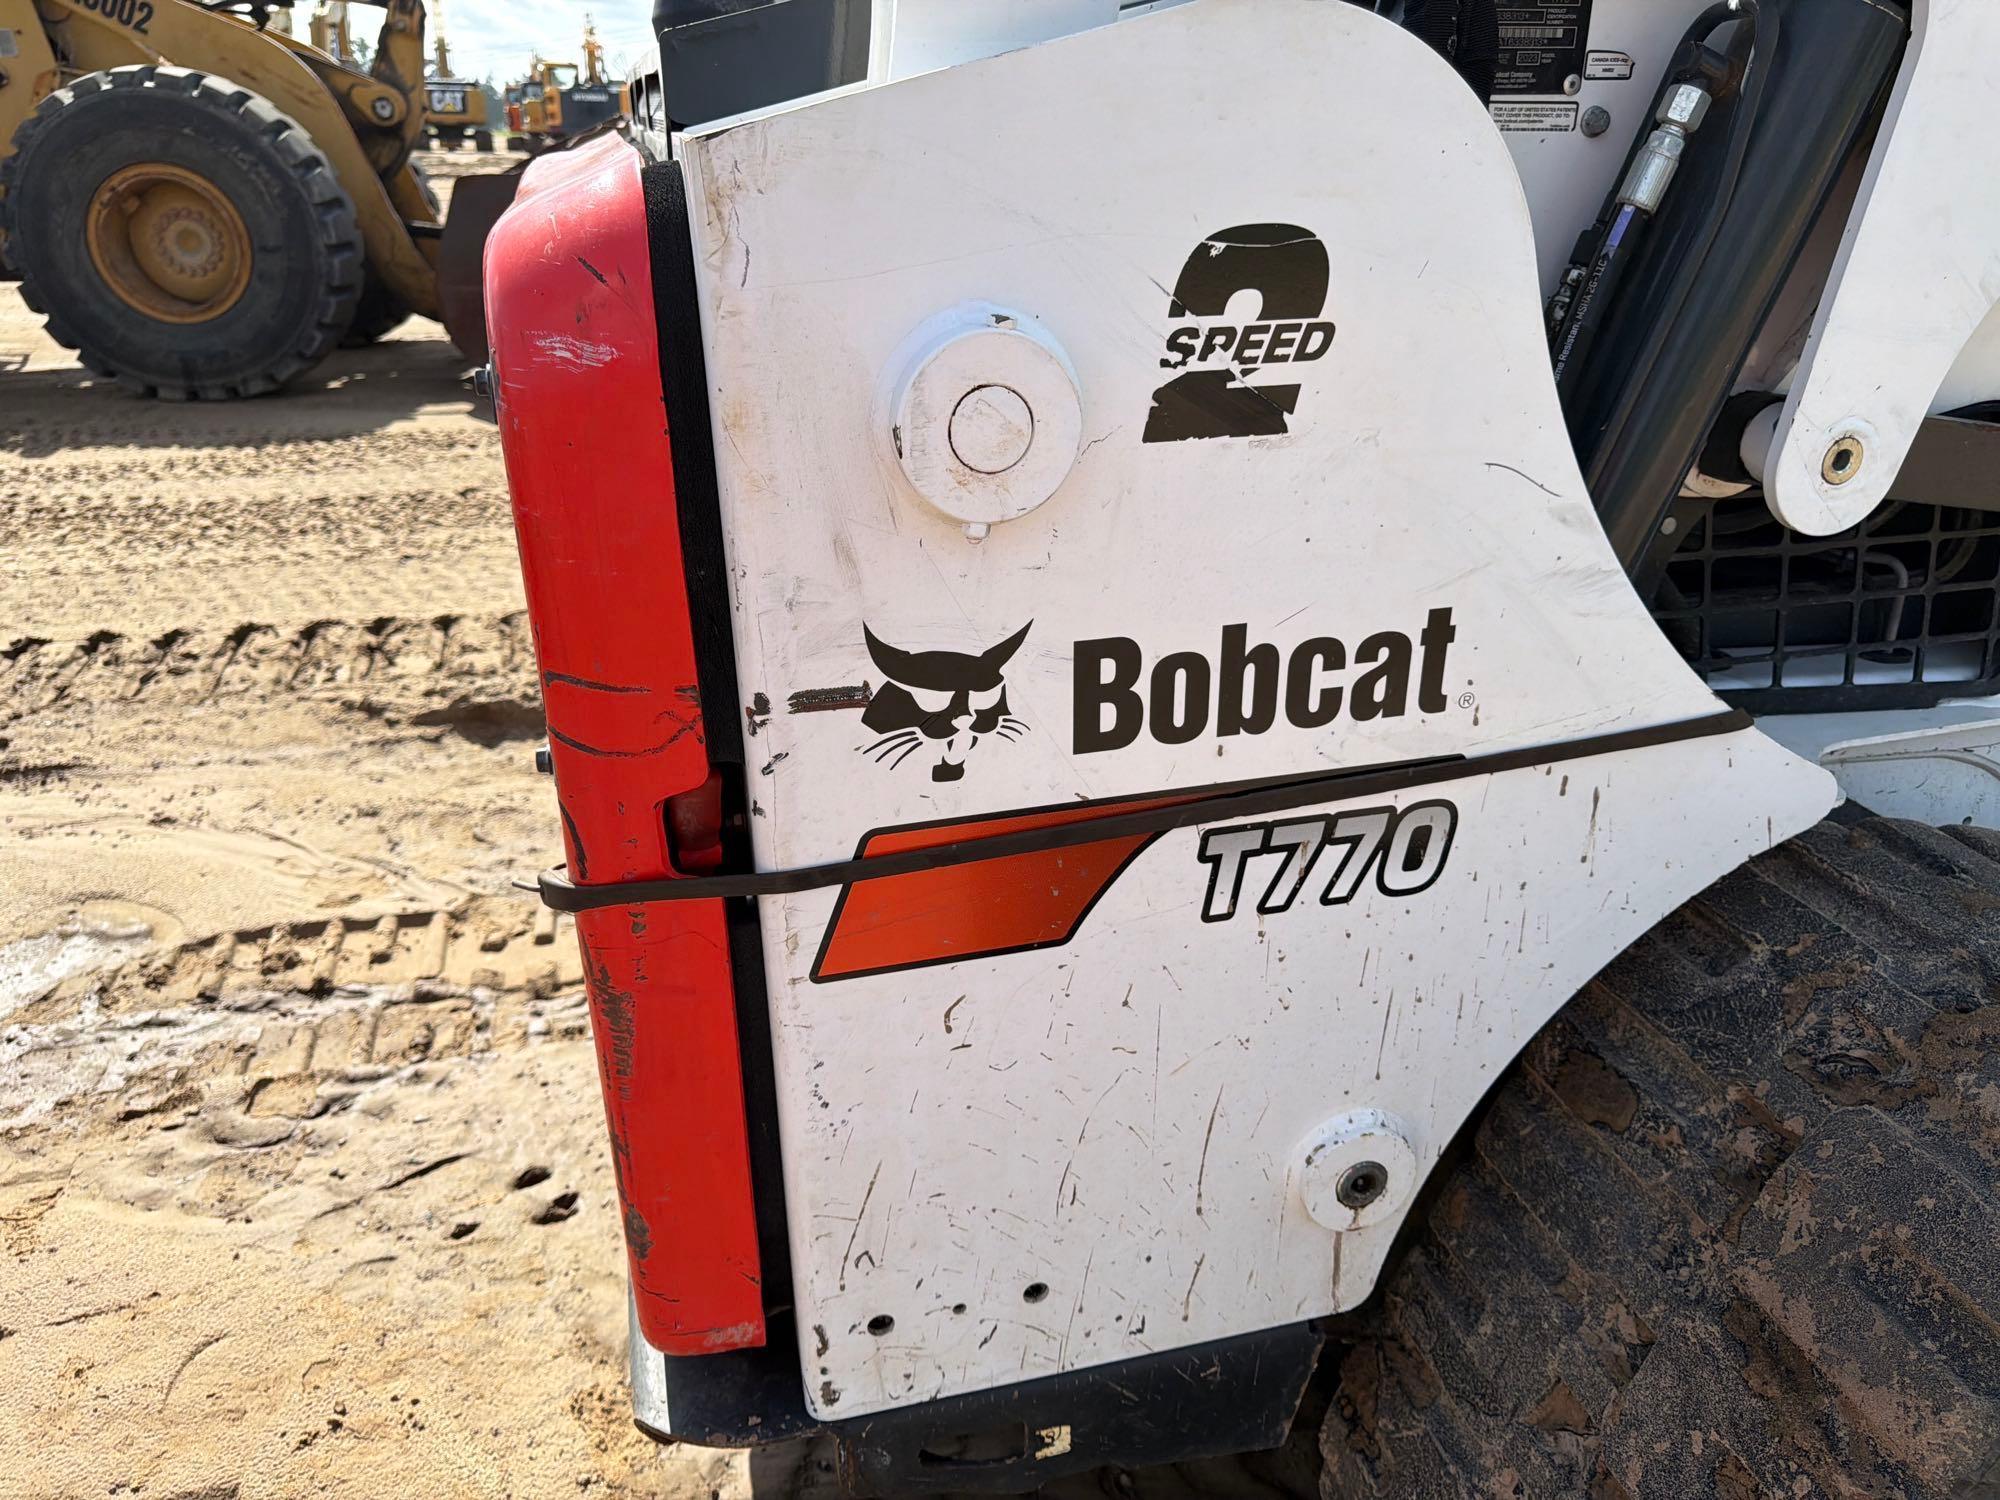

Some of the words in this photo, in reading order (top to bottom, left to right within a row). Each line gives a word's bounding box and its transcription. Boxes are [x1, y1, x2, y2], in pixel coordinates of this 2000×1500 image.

[431, 90, 464, 113] CAT
[1142, 223, 1330, 443] 2
[1159, 321, 1337, 370] SPEED
[1575, 294, 1593, 320] MSHA
[1073, 606, 1457, 755] Bobcat
[1197, 798, 1459, 924] T770
